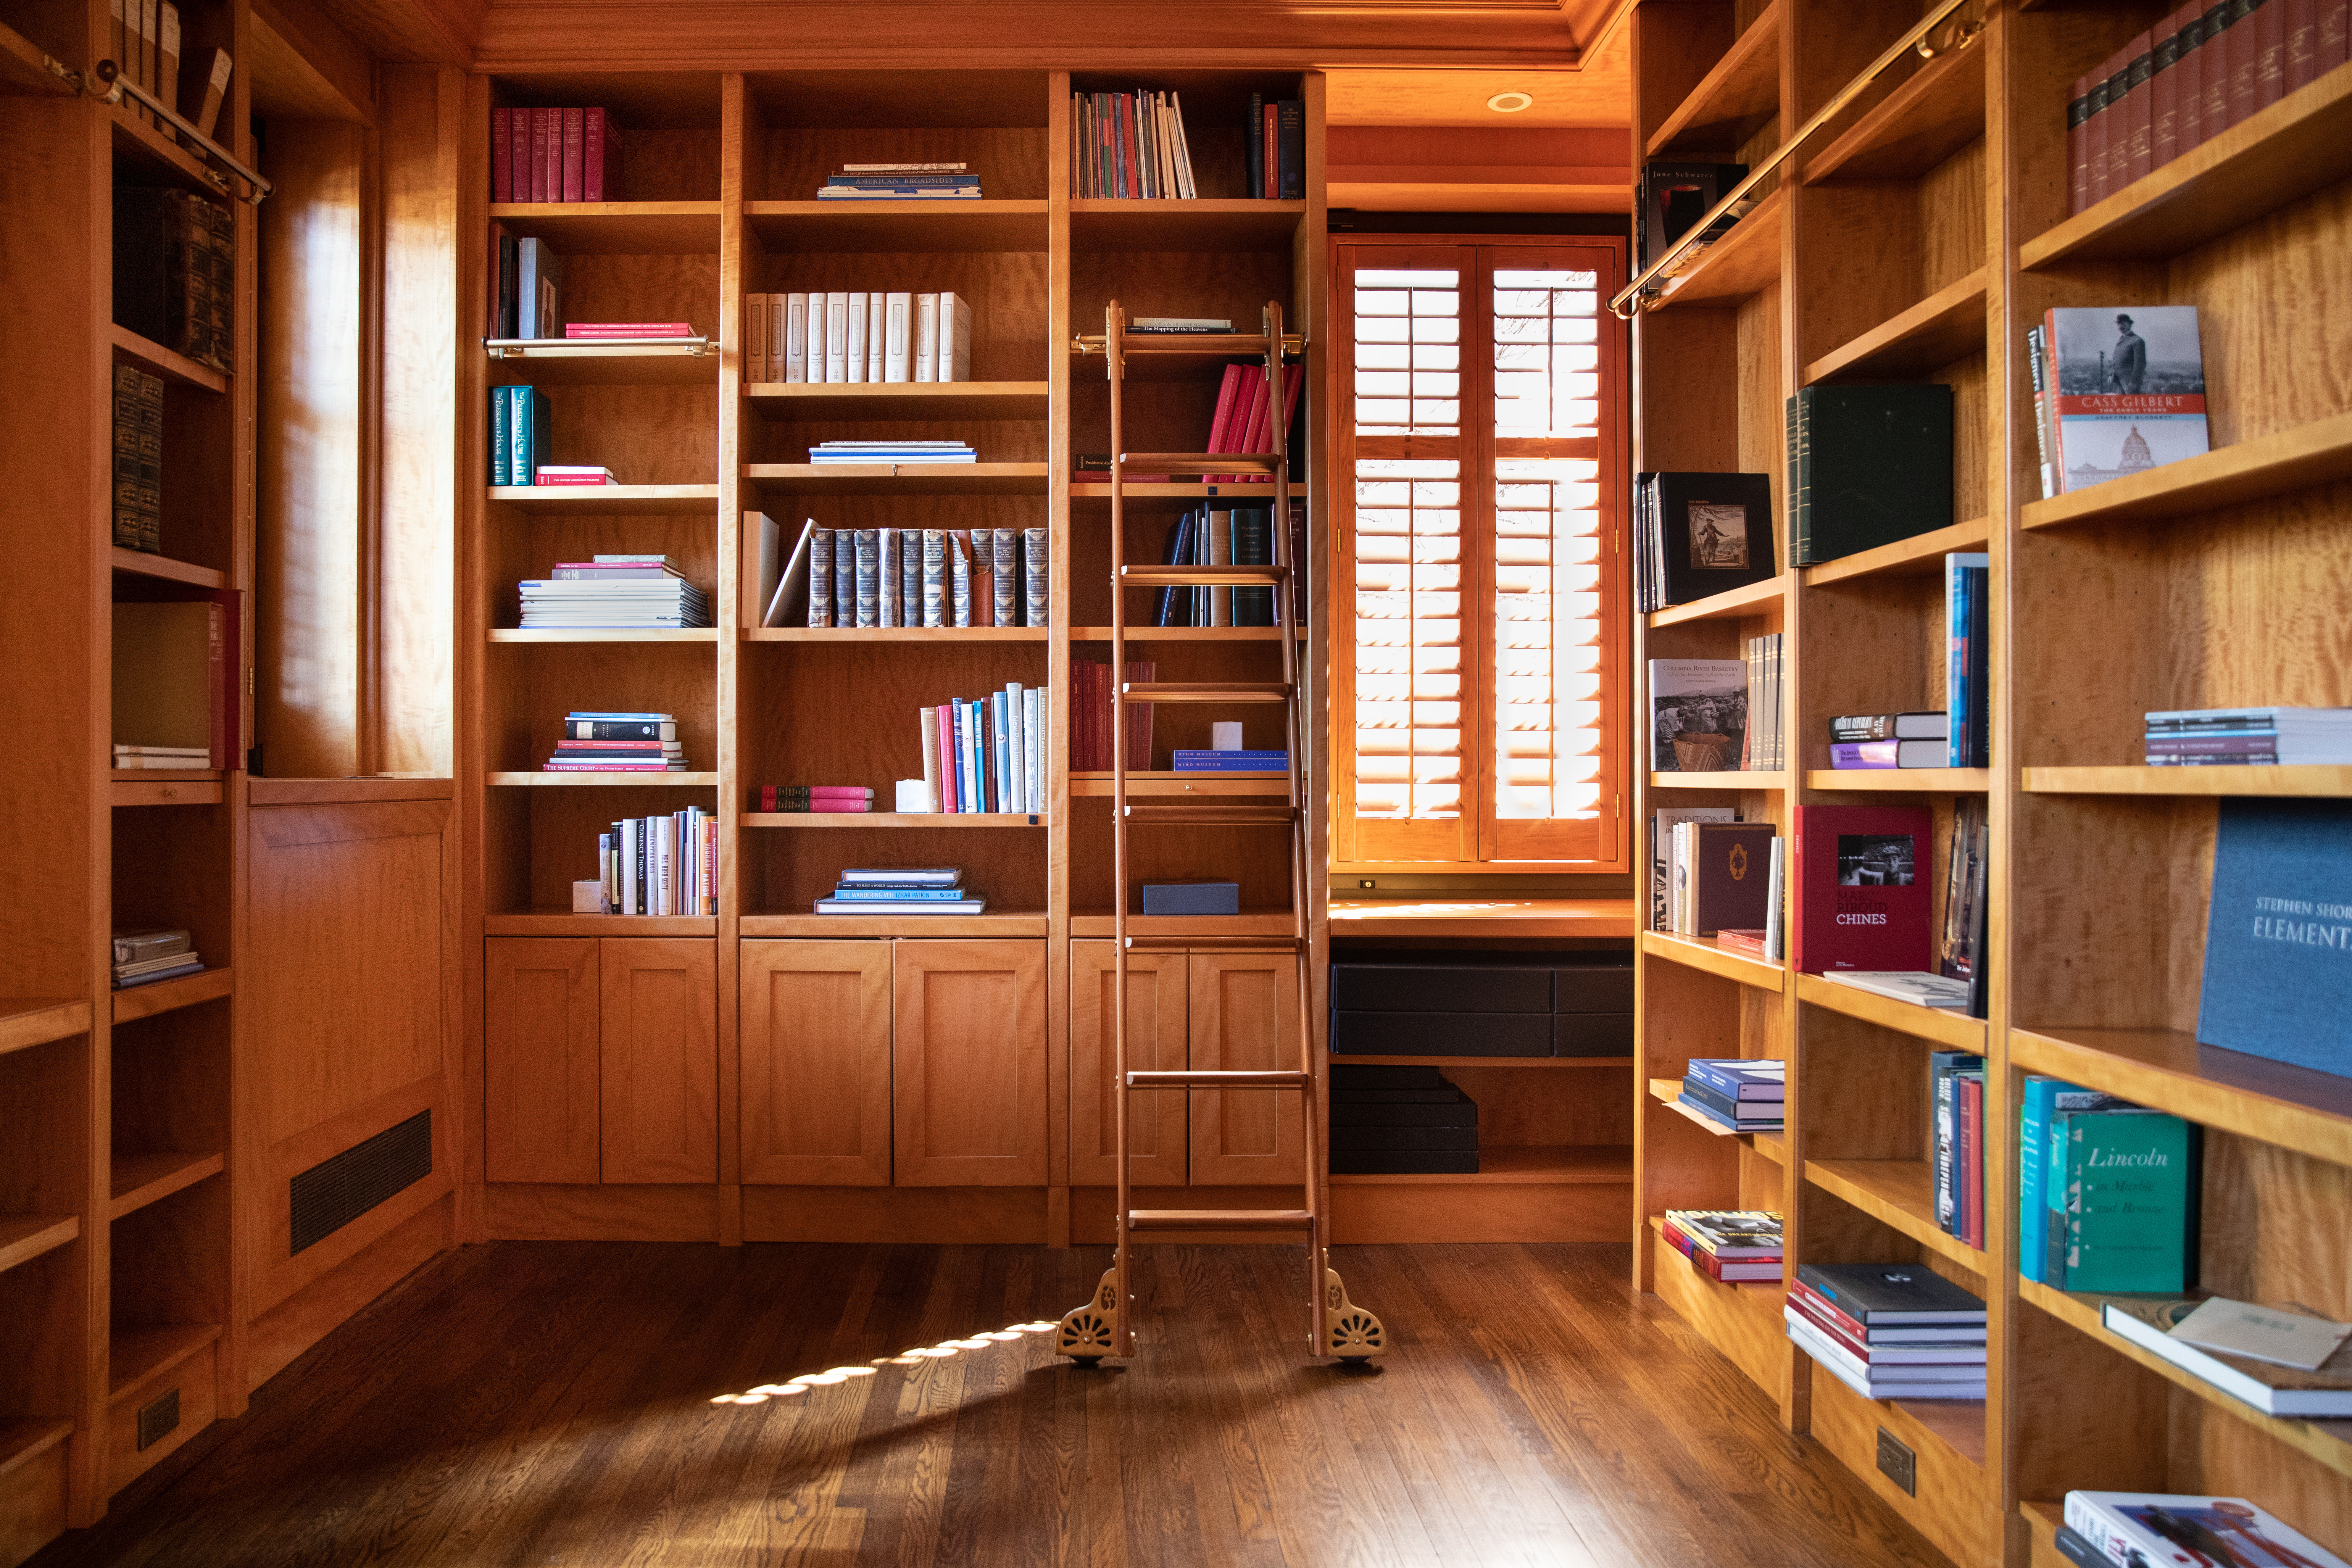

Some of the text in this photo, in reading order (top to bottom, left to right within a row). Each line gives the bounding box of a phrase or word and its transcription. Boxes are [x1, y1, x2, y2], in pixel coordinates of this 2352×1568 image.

[2081, 396, 2183, 407] CASS GILBERT
[496, 399, 504, 434] PRESIDENT'S
[517, 398, 526, 433] PRESIDENT'S
[496, 434, 504, 455] HOUSE
[517, 434, 526, 455] HOUSE
[1835, 716, 1873, 730] AMERICAN REPUBLICS
[1665, 816, 1727, 827] TRADITIONS
[1837, 891, 1873, 901] MARC
[1837, 902, 1887, 912] RIBOUD
[2256, 897, 2312, 915] STEPHEN
[1836, 914, 1886, 924] CHINES
[2254, 916, 2352, 950] ELEMENT
[2088, 1147, 2168, 1167] Lincoln
[2115, 1180, 2154, 1192] Marble
[2094, 1202, 2165, 1213] and Bronze
[1819, 1283, 1837, 1300] WONDER
[1805, 1292, 1836, 1319] CROSSCURRENTS
[1811, 1314, 1825, 1328] WRITING
[1837, 1333, 1846, 1343] WALL
